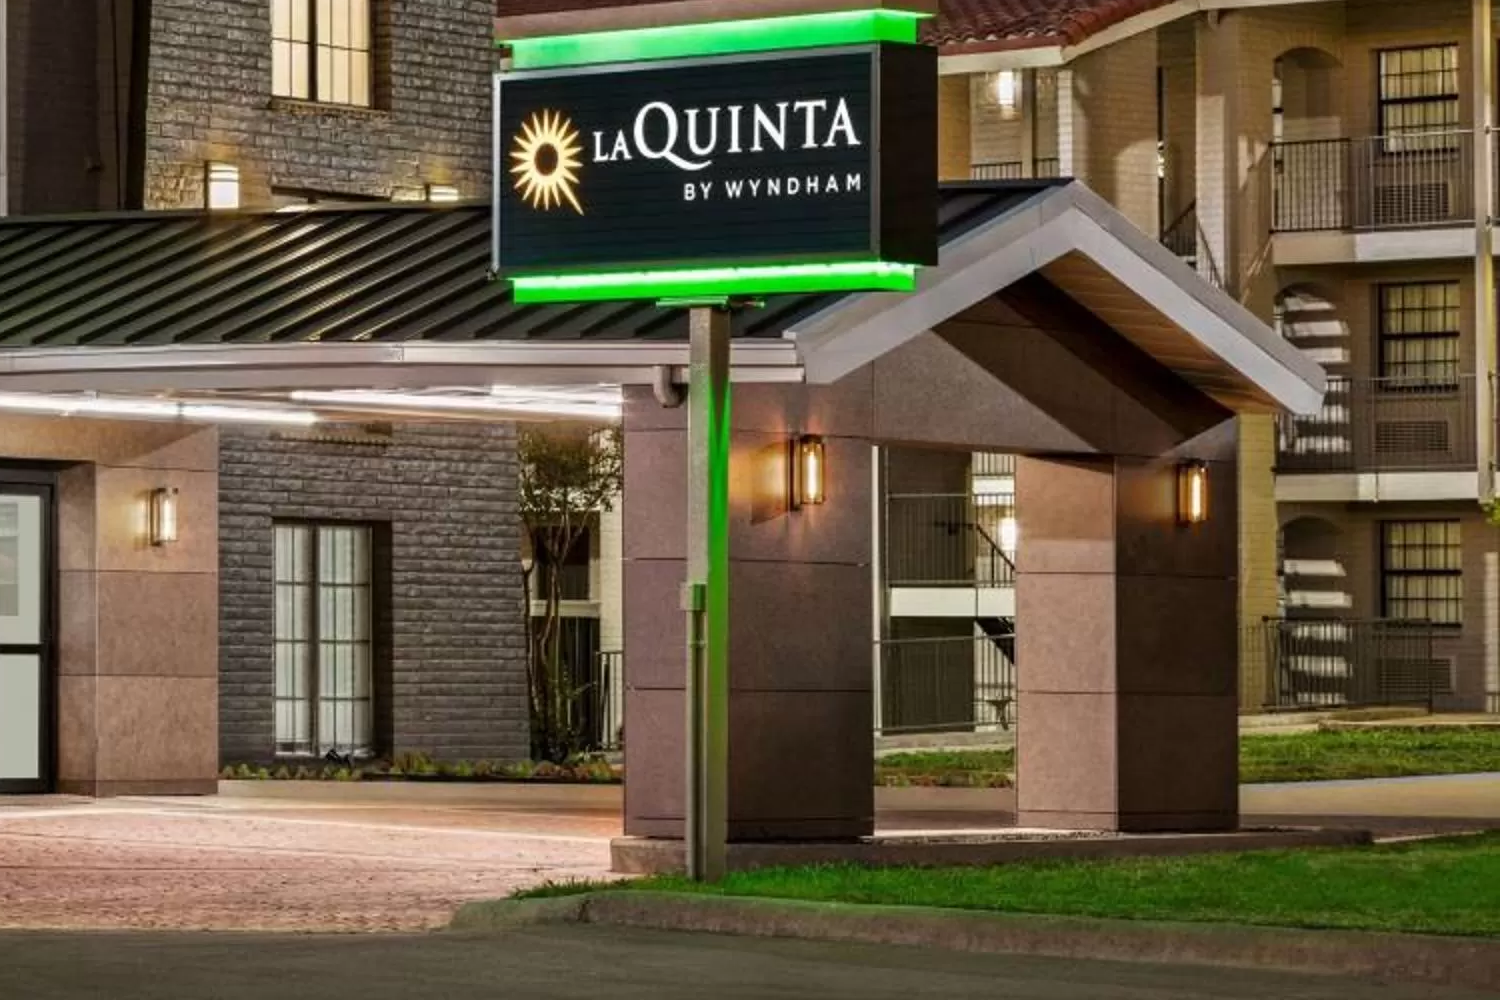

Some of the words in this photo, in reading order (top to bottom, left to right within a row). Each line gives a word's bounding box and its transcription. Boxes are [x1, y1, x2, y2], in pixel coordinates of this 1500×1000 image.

[592, 129, 632, 163] LA
[632, 97, 861, 171] QUINTA
[683, 180, 714, 201] BY
[725, 173, 862, 199] WYNDHAM
